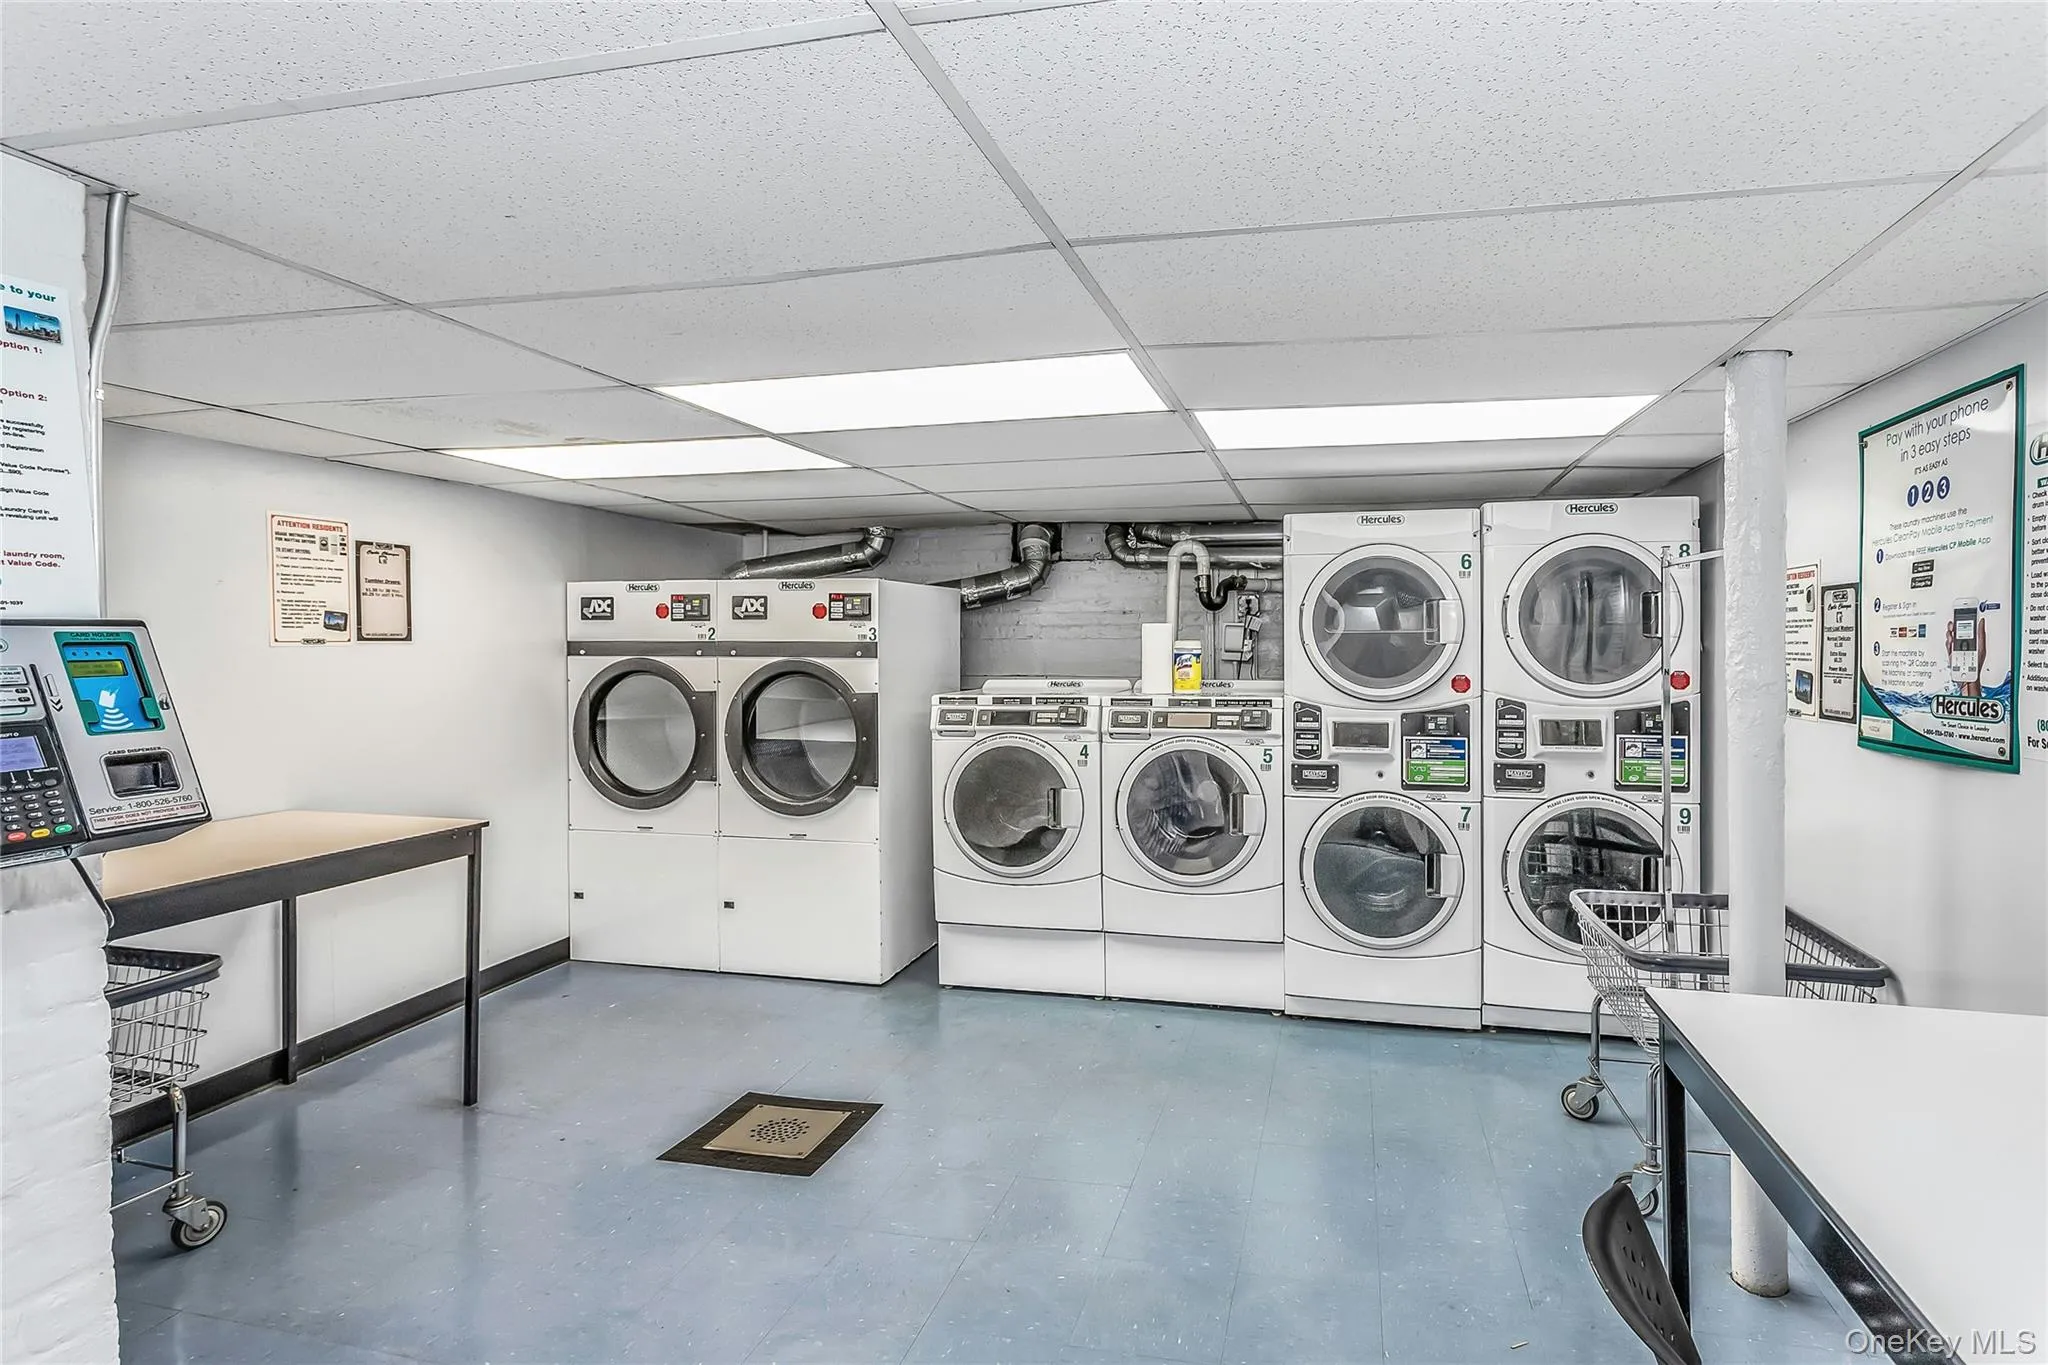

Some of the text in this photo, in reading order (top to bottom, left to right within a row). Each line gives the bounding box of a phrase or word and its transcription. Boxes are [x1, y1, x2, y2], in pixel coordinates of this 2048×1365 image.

[10, 285, 22, 294] to
[27, 290, 56, 302] your
[0, 387, 34, 400] Option
[1886, 398, 1989, 447] Pay with your phone
[1900, 427, 1970, 462] in 3 easy steps
[1929, 460, 1940, 471] EASY
[1941, 458, 1948, 466] AS
[2032, 490, 2047, 499] Check
[1570, 504, 1615, 513] Hercules
[1361, 515, 1402, 524] Hercules
[2032, 514, 2047, 522] Empty
[277, 520, 343, 532] ATTENTION RESIDENTS
[1949, 541, 1956, 549] CP
[1957, 538, 1976, 548] Mobile
[4, 550, 37, 559] laundry
[1679, 544, 1690, 558] 8
[1461, 554, 1472, 570] 6
[781, 581, 813, 589] Hercules
[708, 627, 716, 640] 2
[869, 627, 877, 641] 3
[1936, 696, 1999, 718] Hercules
[2027, 736, 2039, 748] For
[1080, 744, 1089, 759] 4
[1263, 749, 1273, 763] 5
[88, 794, 193, 816] Service: 1-800-526-5760
[1461, 807, 1472, 822] 7
[1680, 808, 1692, 825] 9
